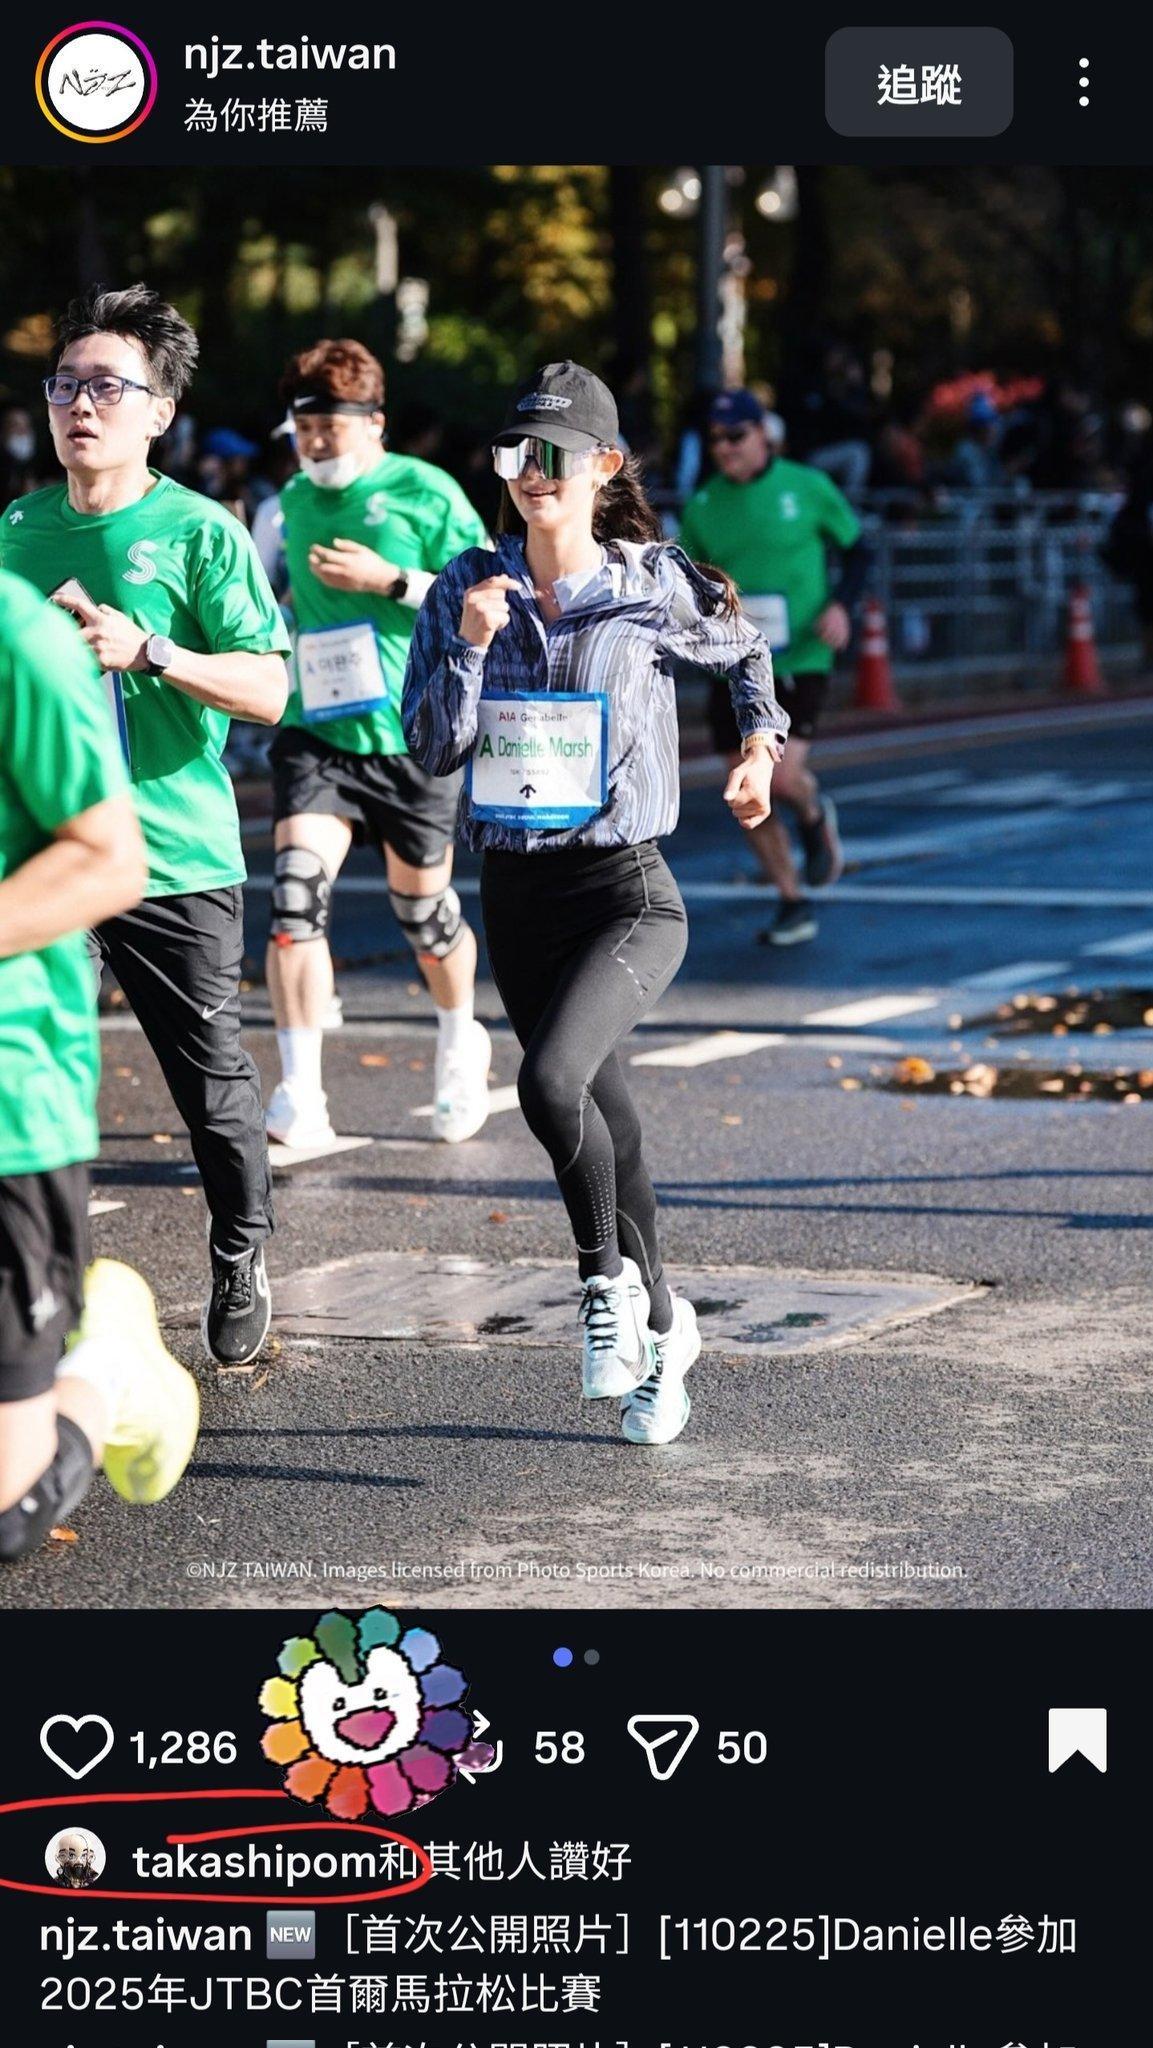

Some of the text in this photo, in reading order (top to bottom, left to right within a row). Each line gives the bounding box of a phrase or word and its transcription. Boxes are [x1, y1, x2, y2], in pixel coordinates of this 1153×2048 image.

[184, 34, 397, 79] njz.taiwan
[876, 63, 963, 106] 追蹤
[183, 97, 329, 134] 為你推薦
[122, 540, 160, 585] S
[498, 711, 517, 722] AIA
[480, 734, 593, 759] A Danielle Marsh
[129, 1730, 237, 1770] 1,286
[534, 1730, 585, 1766] 58
[717, 1730, 767, 1766] 50
[40, 1916, 252, 1961] njz.taiwan
[40, 1972, 602, 2014] 2025年JTBC首爾馬拉松比賽
